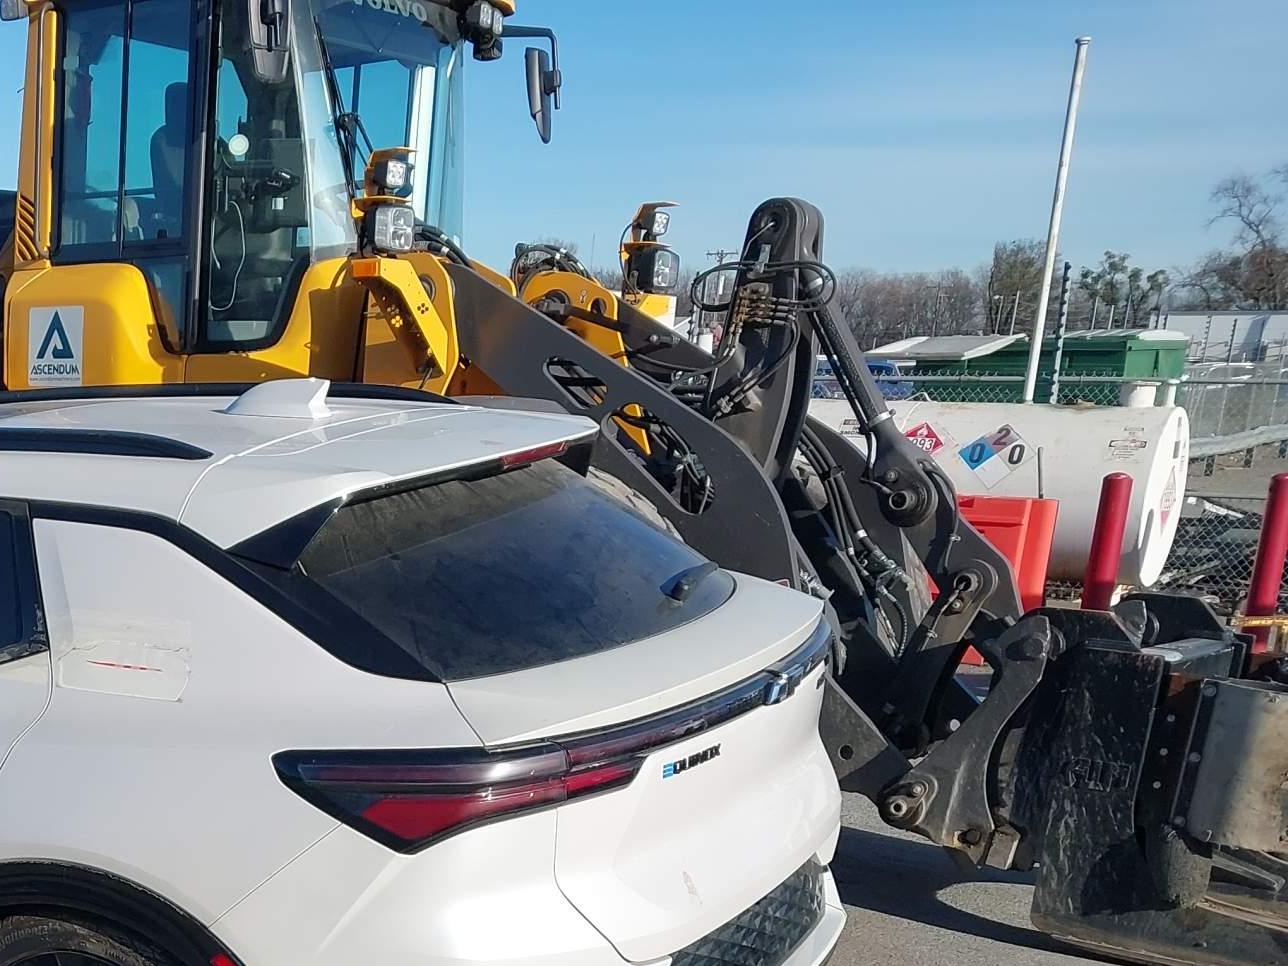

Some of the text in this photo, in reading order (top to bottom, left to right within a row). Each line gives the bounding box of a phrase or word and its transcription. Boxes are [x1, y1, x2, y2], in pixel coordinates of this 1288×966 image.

[354, 0, 427, 21] OLVO
[30, 364, 80, 376] ASCENDUM
[992, 427, 1012, 446] 2
[968, 442, 985, 464] 0
[1007, 443, 1026, 465] 0
[662, 743, 722, 779] EQUINOX
